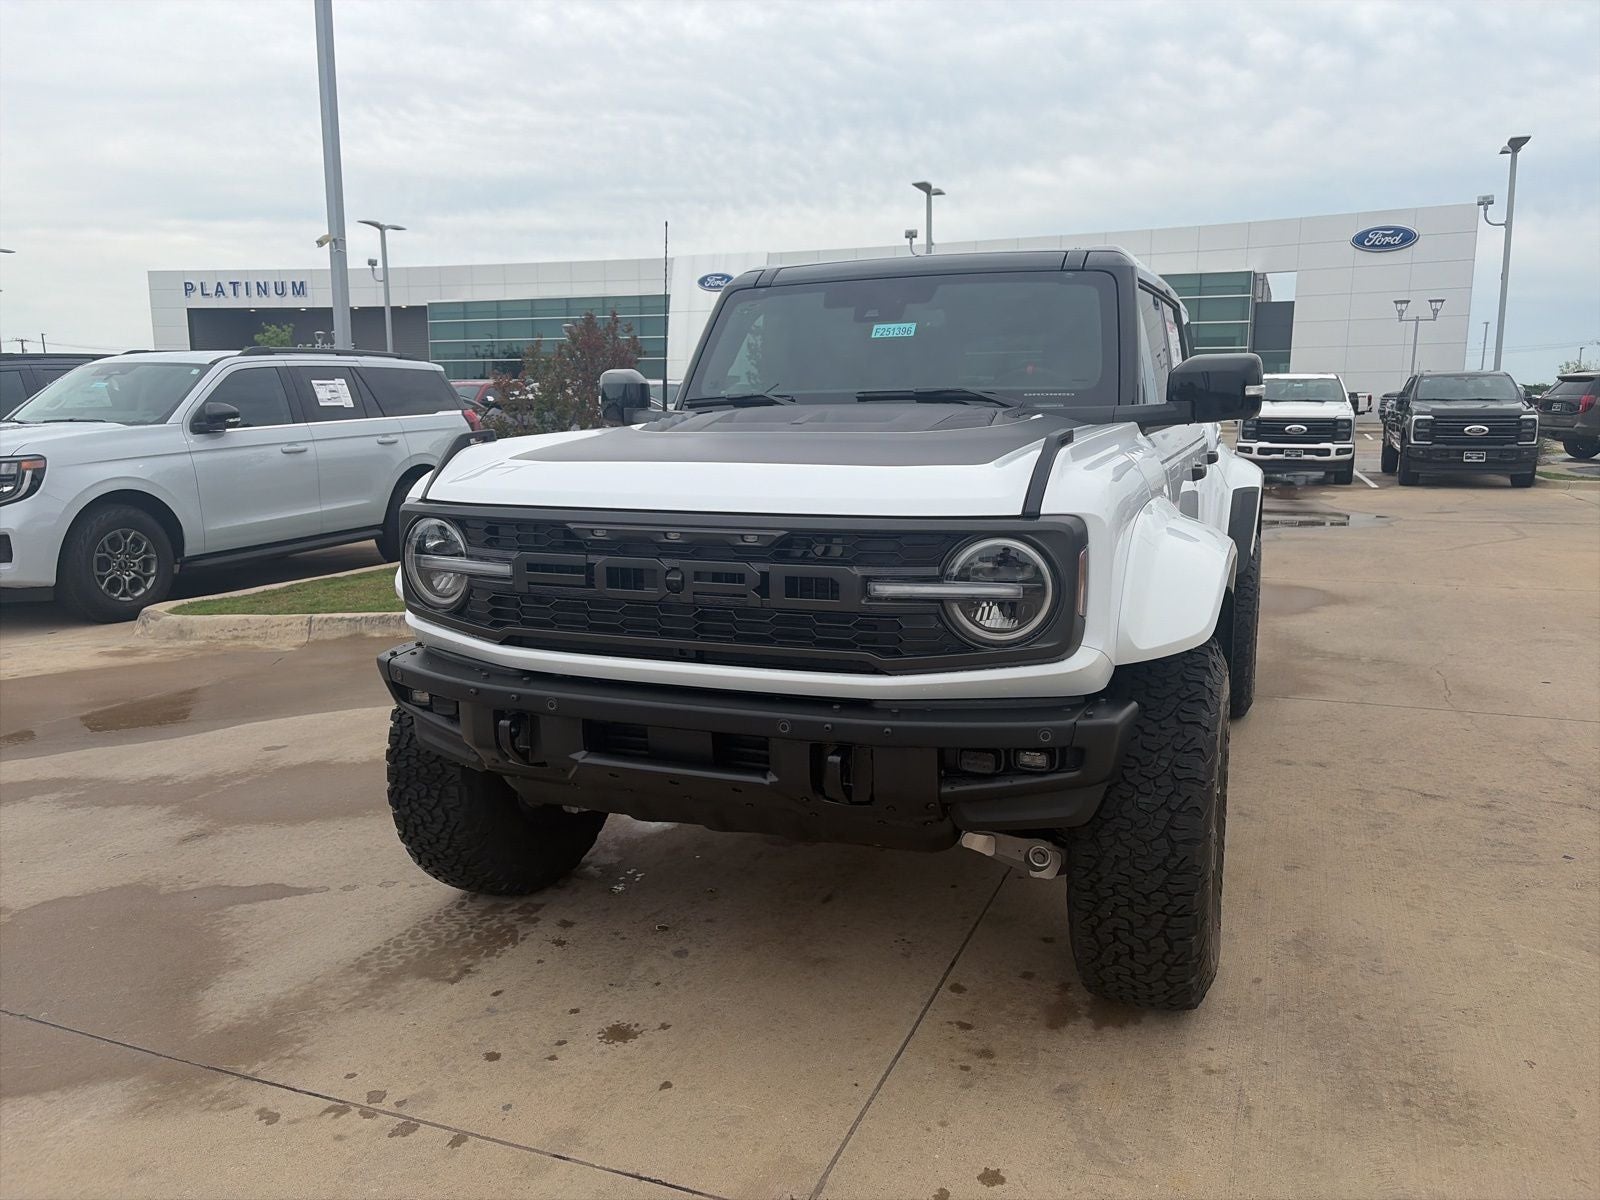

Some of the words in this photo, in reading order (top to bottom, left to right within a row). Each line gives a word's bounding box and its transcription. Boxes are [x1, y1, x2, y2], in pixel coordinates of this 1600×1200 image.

[1364, 230, 1403, 245] Ford
[704, 275, 728, 287] Ford
[184, 281, 306, 297] PLATINUM
[874, 327, 912, 337] F251396
[511, 551, 865, 613] FORD
